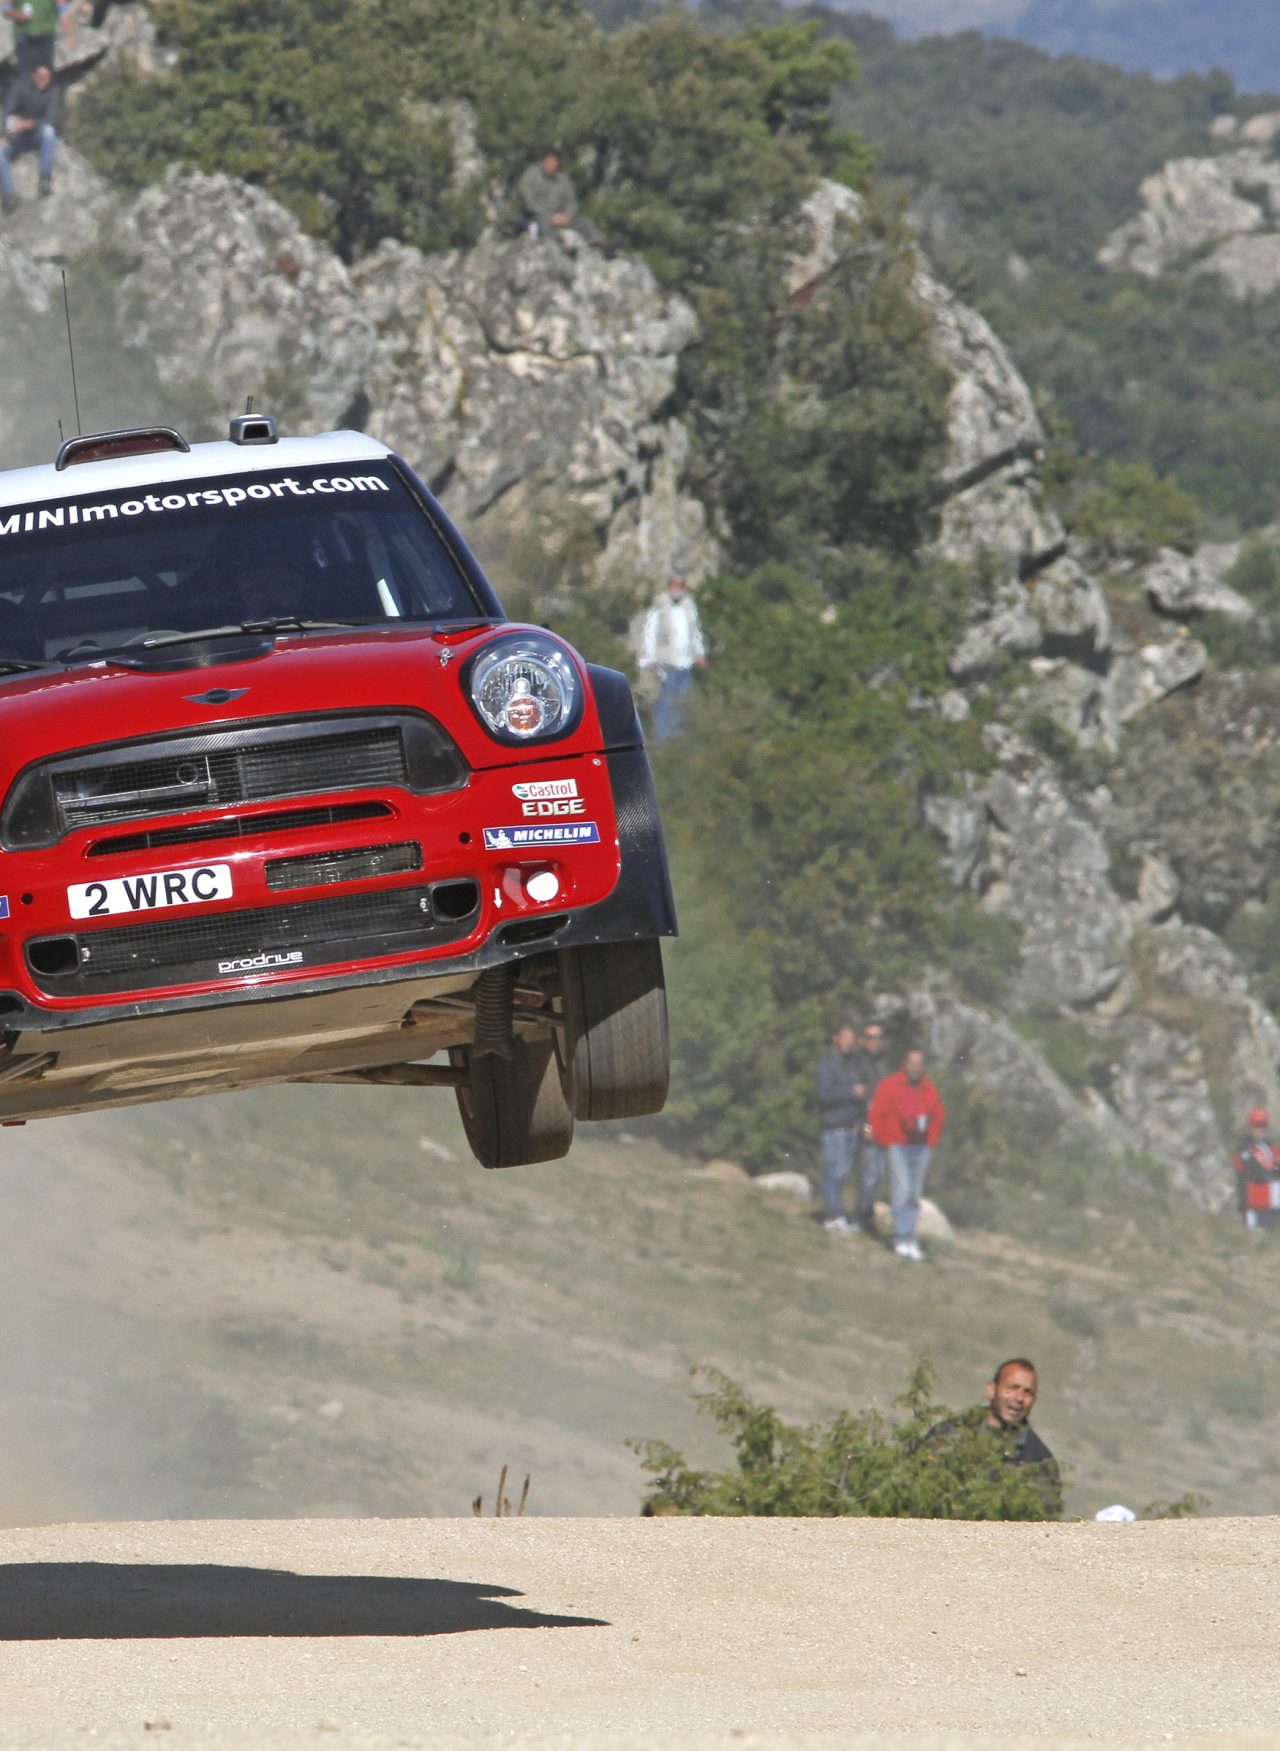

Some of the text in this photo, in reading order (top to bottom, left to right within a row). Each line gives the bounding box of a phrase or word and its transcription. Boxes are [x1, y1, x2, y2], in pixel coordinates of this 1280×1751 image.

[529, 782, 574, 797] Castrol
[522, 798, 587, 816] EDGE
[513, 826, 592, 841] MICHELIN
[85, 868, 219, 916] 2 WRC
[218, 951, 304, 973] prodrive
